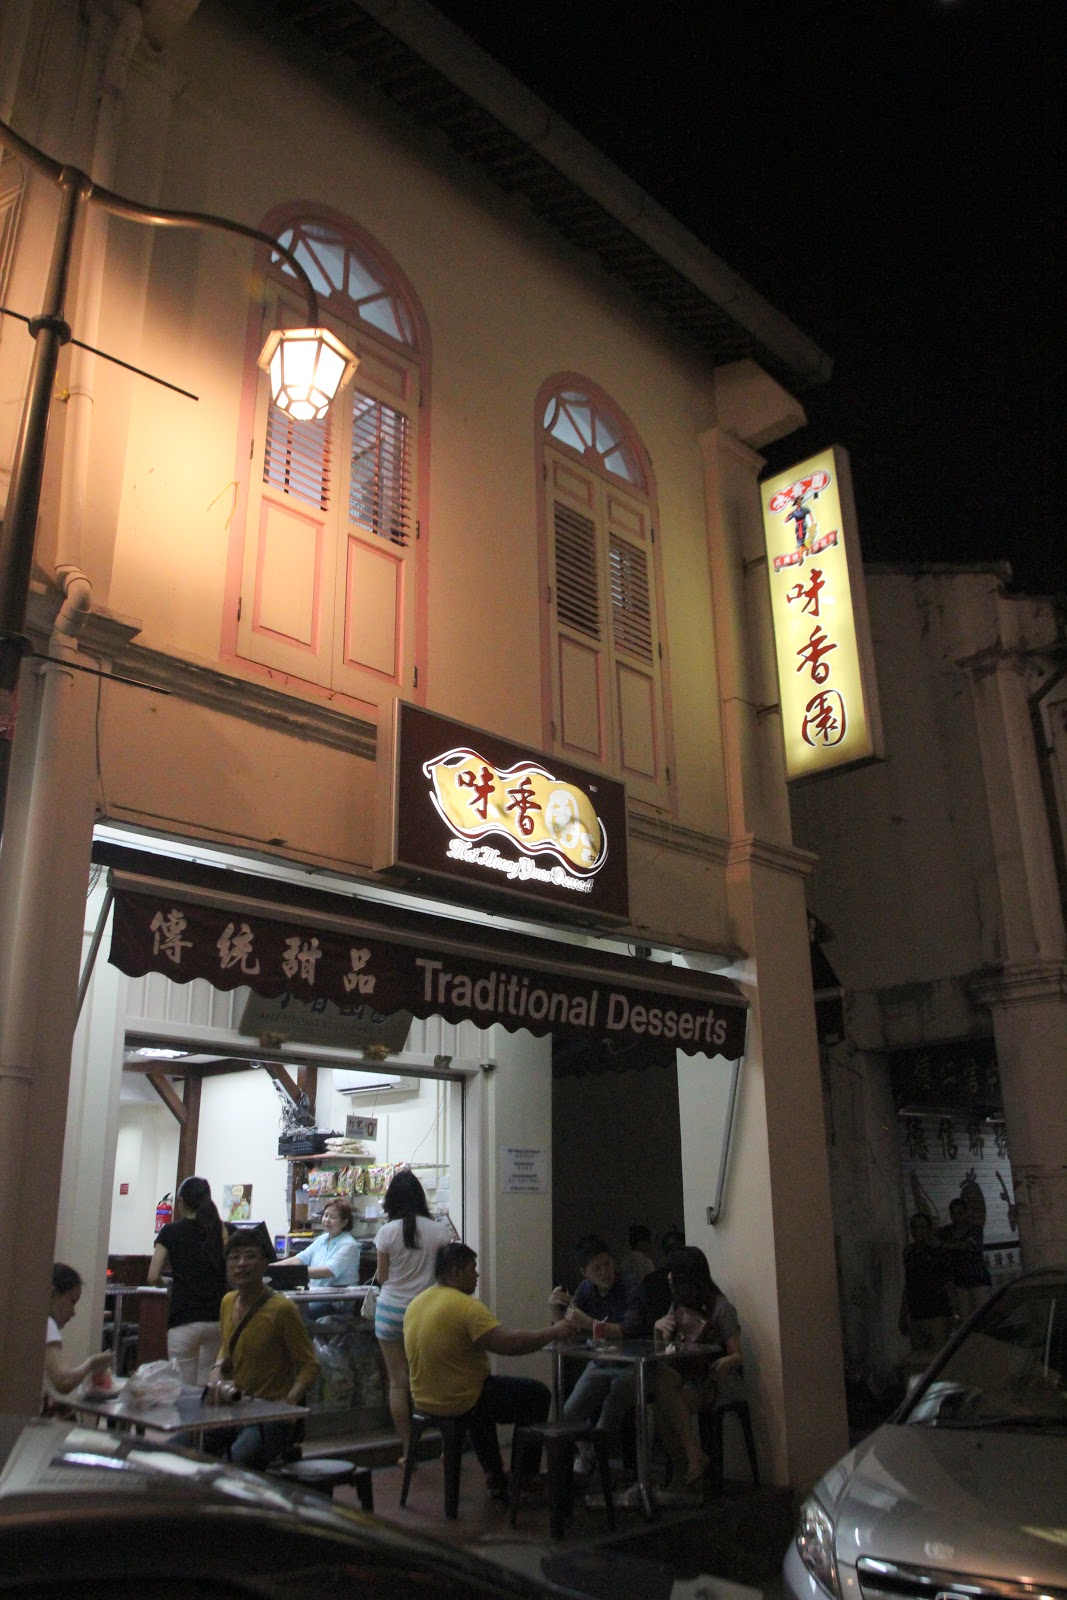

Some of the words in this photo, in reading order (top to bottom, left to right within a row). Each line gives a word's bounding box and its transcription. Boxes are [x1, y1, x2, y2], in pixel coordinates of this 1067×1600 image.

[446, 839, 480, 863] Mei
[415, 957, 597, 1027] Traditional
[606, 992, 727, 1045] Desserts
